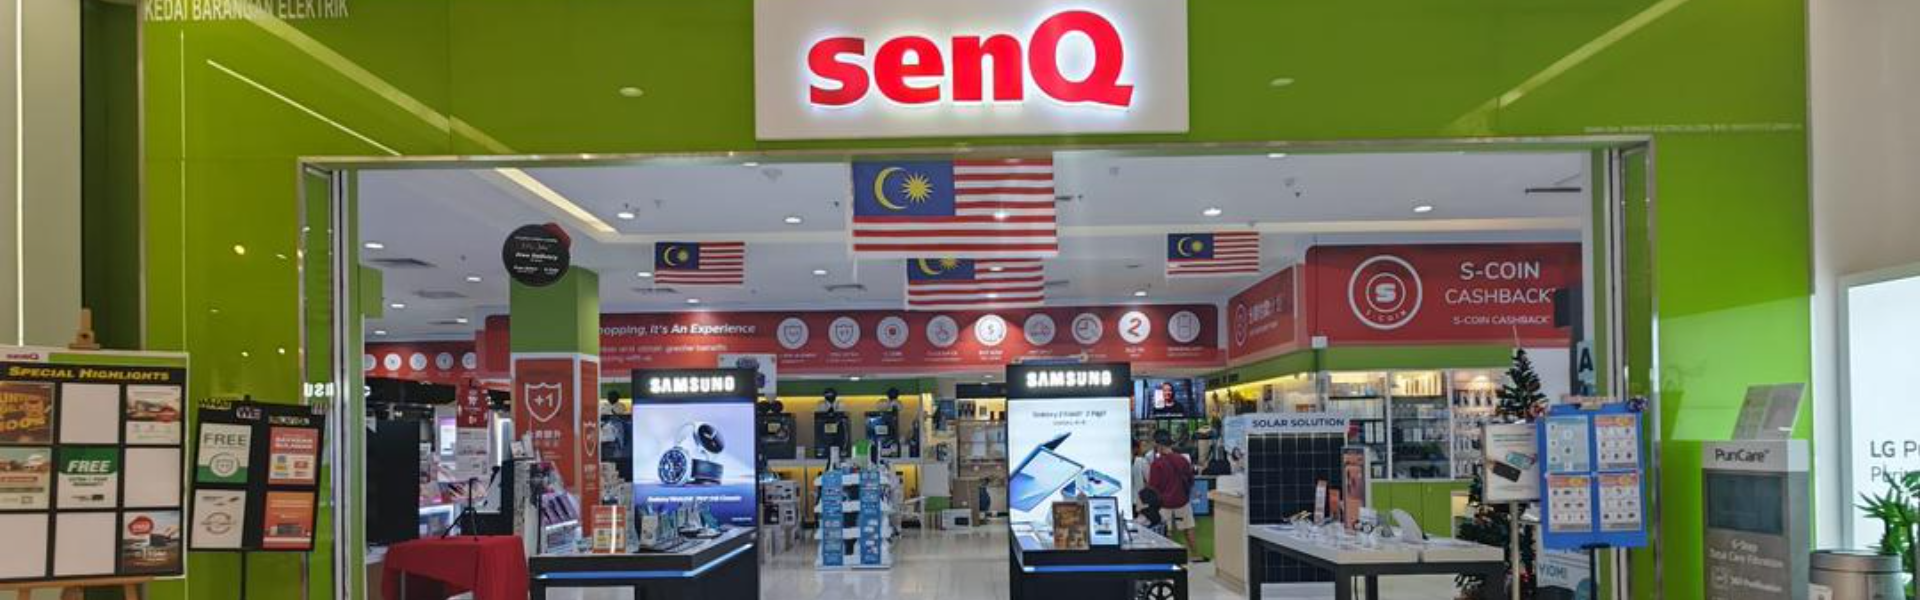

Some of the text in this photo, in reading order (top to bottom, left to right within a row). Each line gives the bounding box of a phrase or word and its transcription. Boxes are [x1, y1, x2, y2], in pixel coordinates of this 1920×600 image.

[144, 0, 188, 20] KEDAI
[278, 0, 349, 18] ELEKTRIK
[807, 10, 1134, 107] senQ
[1460, 261, 1541, 280] S-COIN
[671, 324, 688, 333] An
[690, 323, 755, 335] Experience
[650, 376, 735, 393] SAMSUNG
[1026, 370, 1112, 387] SAMSUNG
[1252, 418, 1345, 428] SOLAR SOLUTION
[203, 432, 247, 446] FREE
[1870, 440, 1920, 458] LG P
[67, 460, 111, 473] FREE
